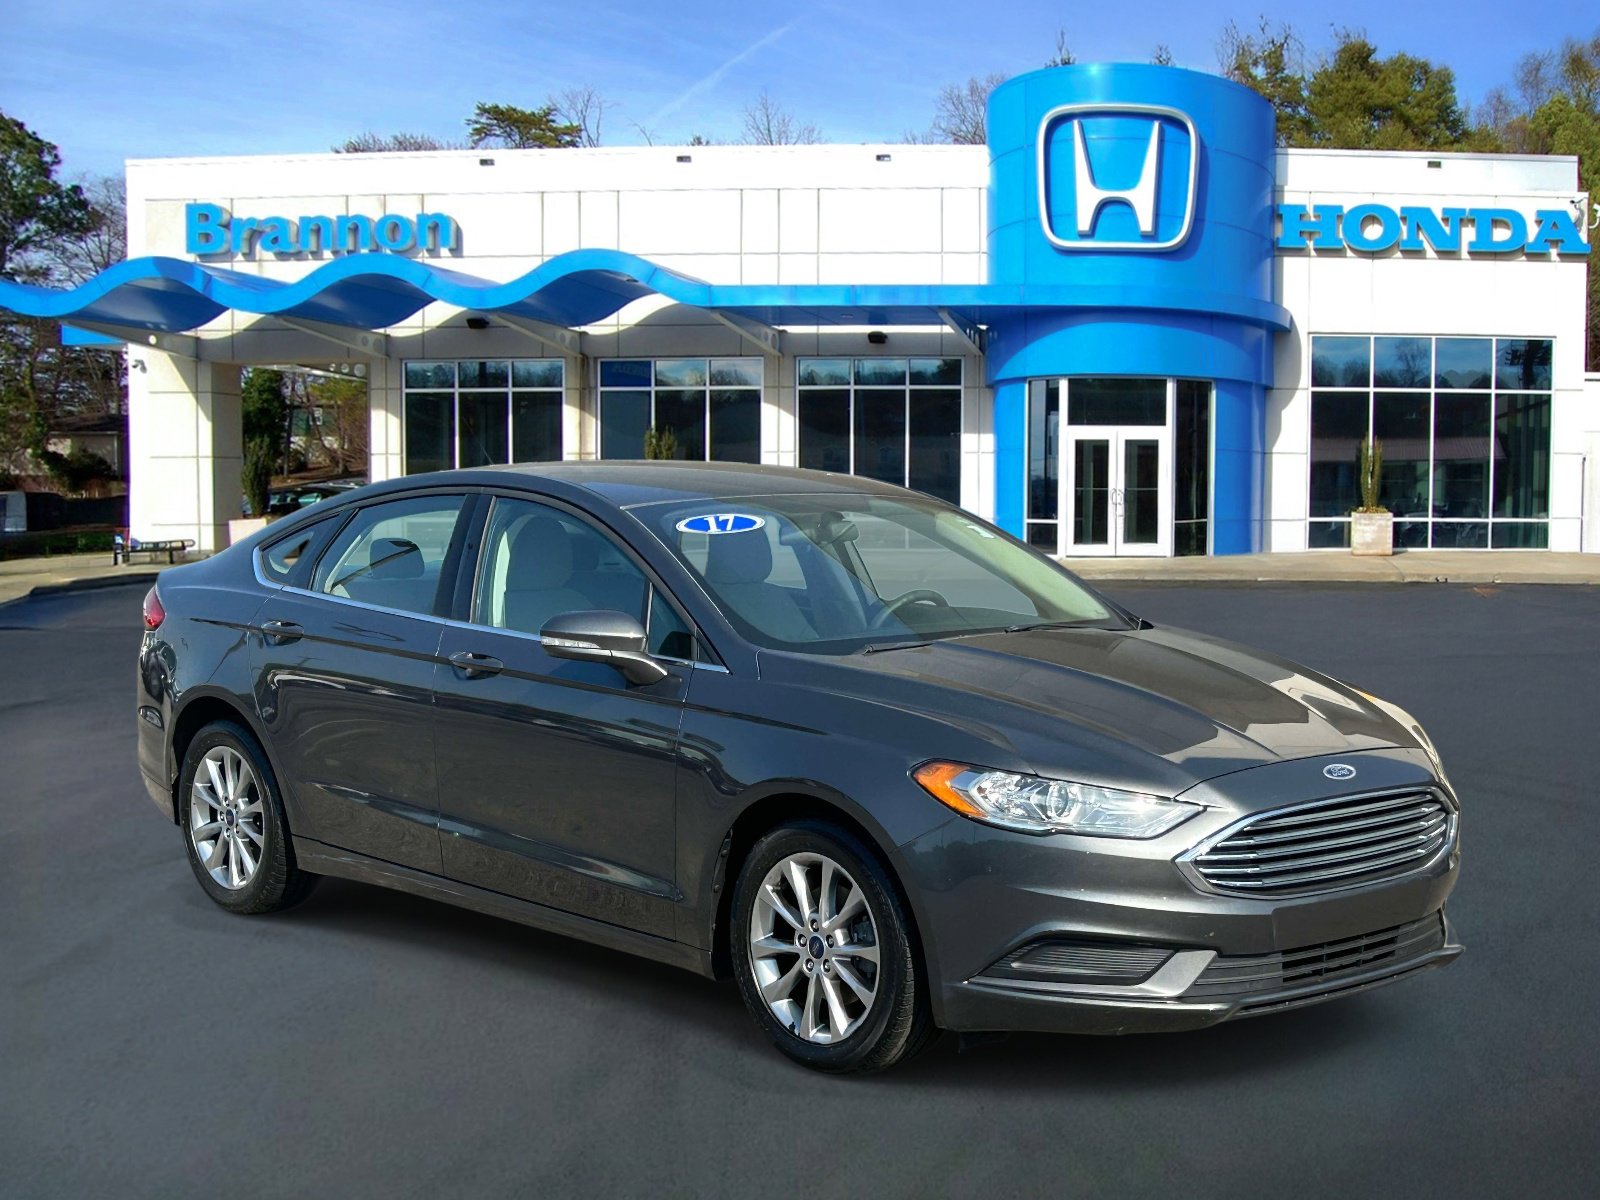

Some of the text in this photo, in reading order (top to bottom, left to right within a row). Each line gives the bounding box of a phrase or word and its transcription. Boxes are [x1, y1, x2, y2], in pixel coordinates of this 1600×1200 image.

[185, 202, 455, 255] Brannon
[1276, 203, 1591, 254] HONDA
[704, 515, 735, 533] 17
